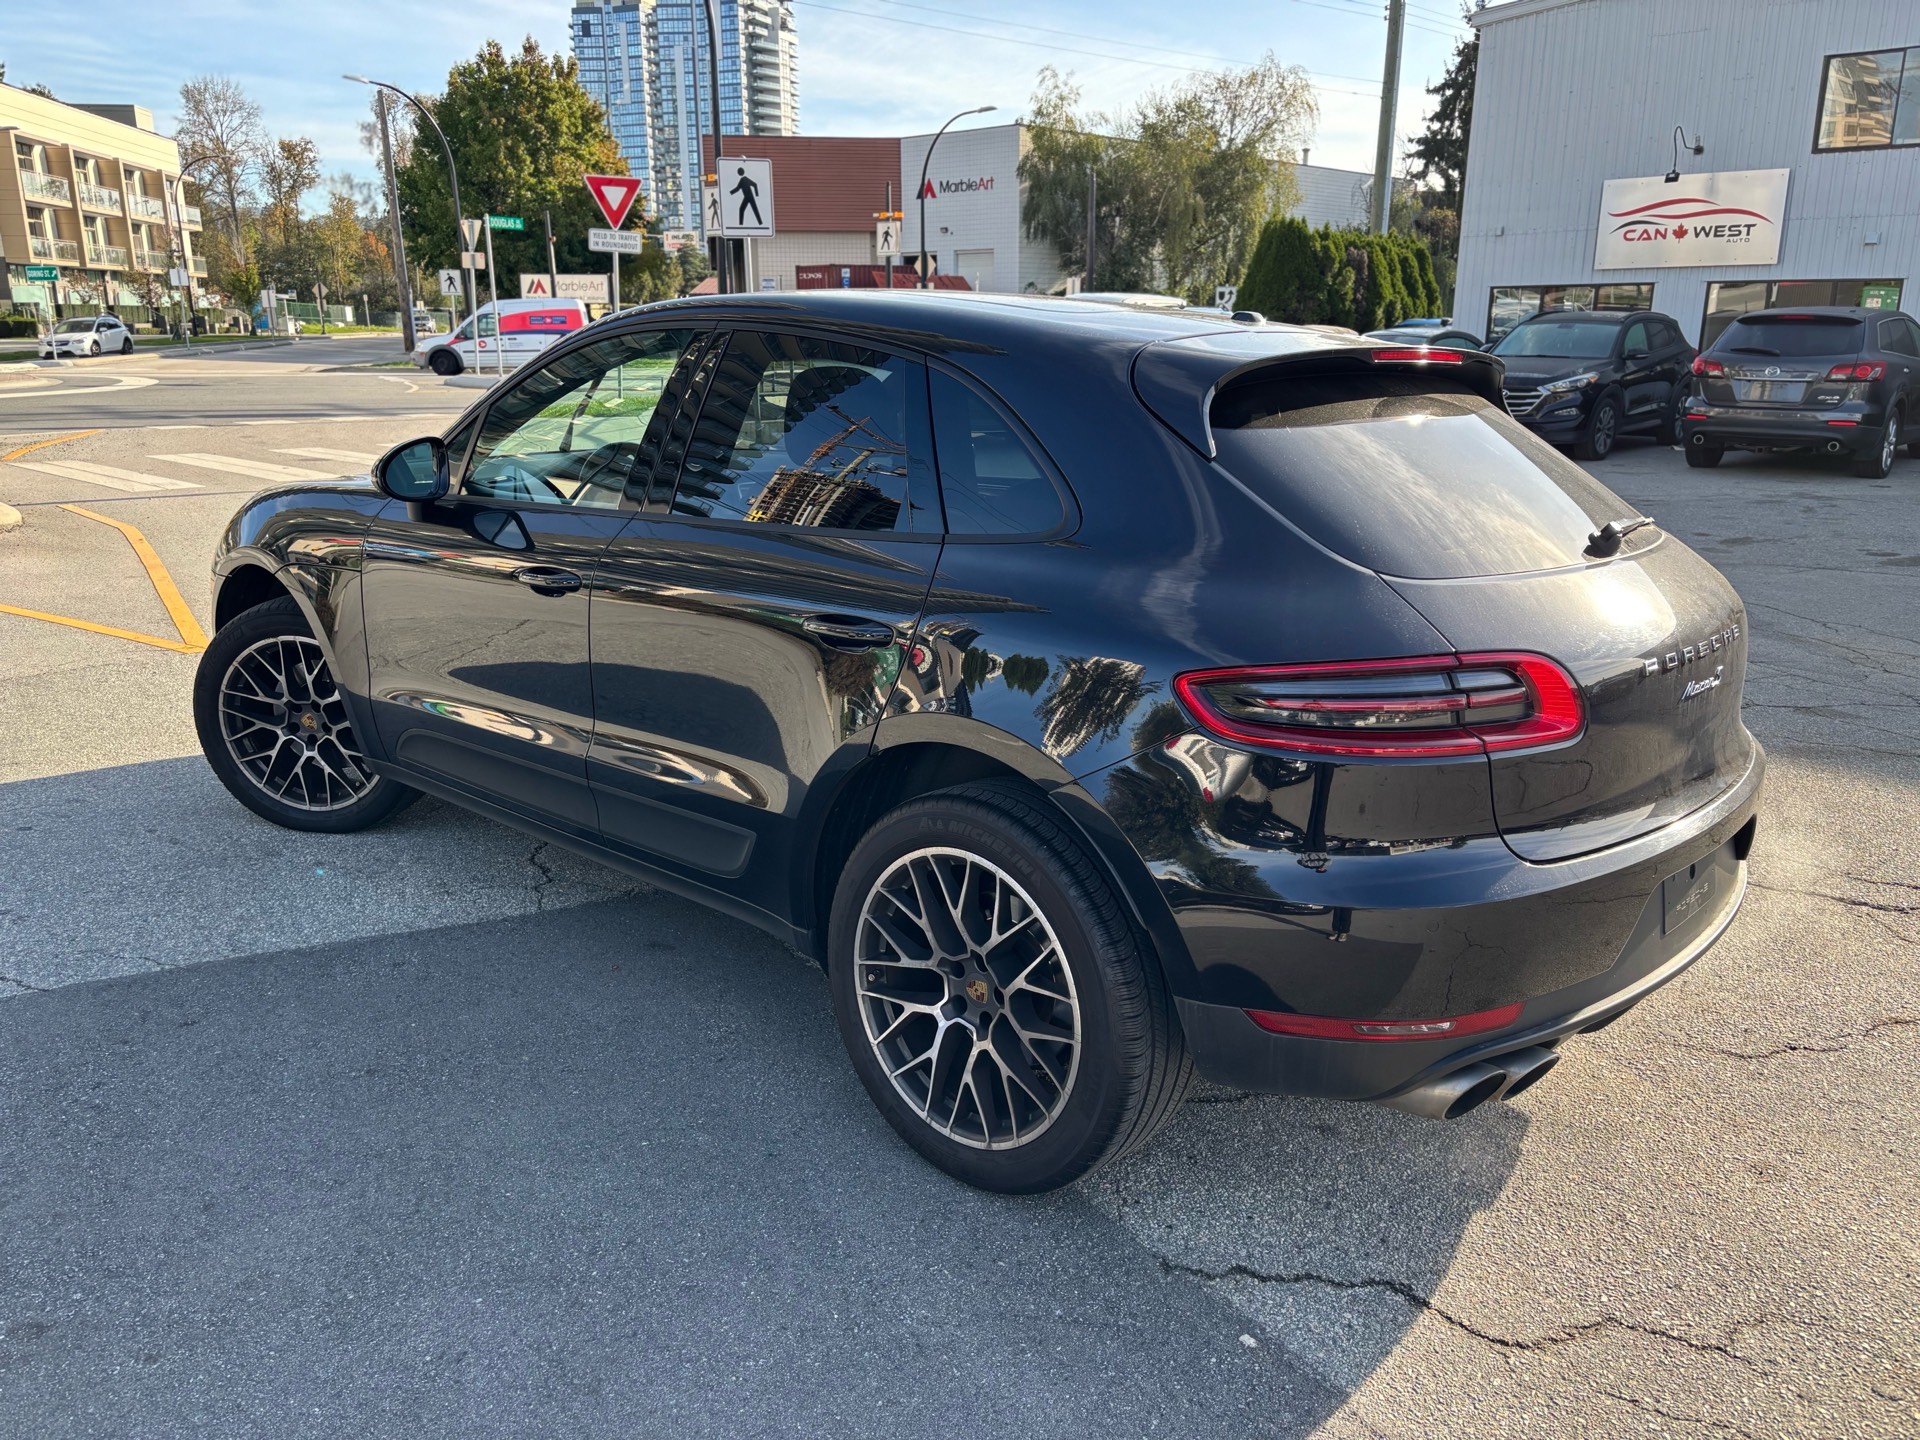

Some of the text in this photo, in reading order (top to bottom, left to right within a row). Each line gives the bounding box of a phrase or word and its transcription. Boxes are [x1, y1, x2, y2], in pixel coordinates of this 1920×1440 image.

[939, 176, 995, 194] MarbleArt
[490, 216, 515, 229] DOUGLAS
[593, 232, 608, 240] YIELD
[618, 234, 638, 242] TRAFFIC
[1623, 223, 1757, 242] CAN WEST
[601, 241, 638, 250] ROUNDABOUT
[1643, 624, 1740, 677] PORSCHE
[947, 820, 1035, 876] MICHELIN
